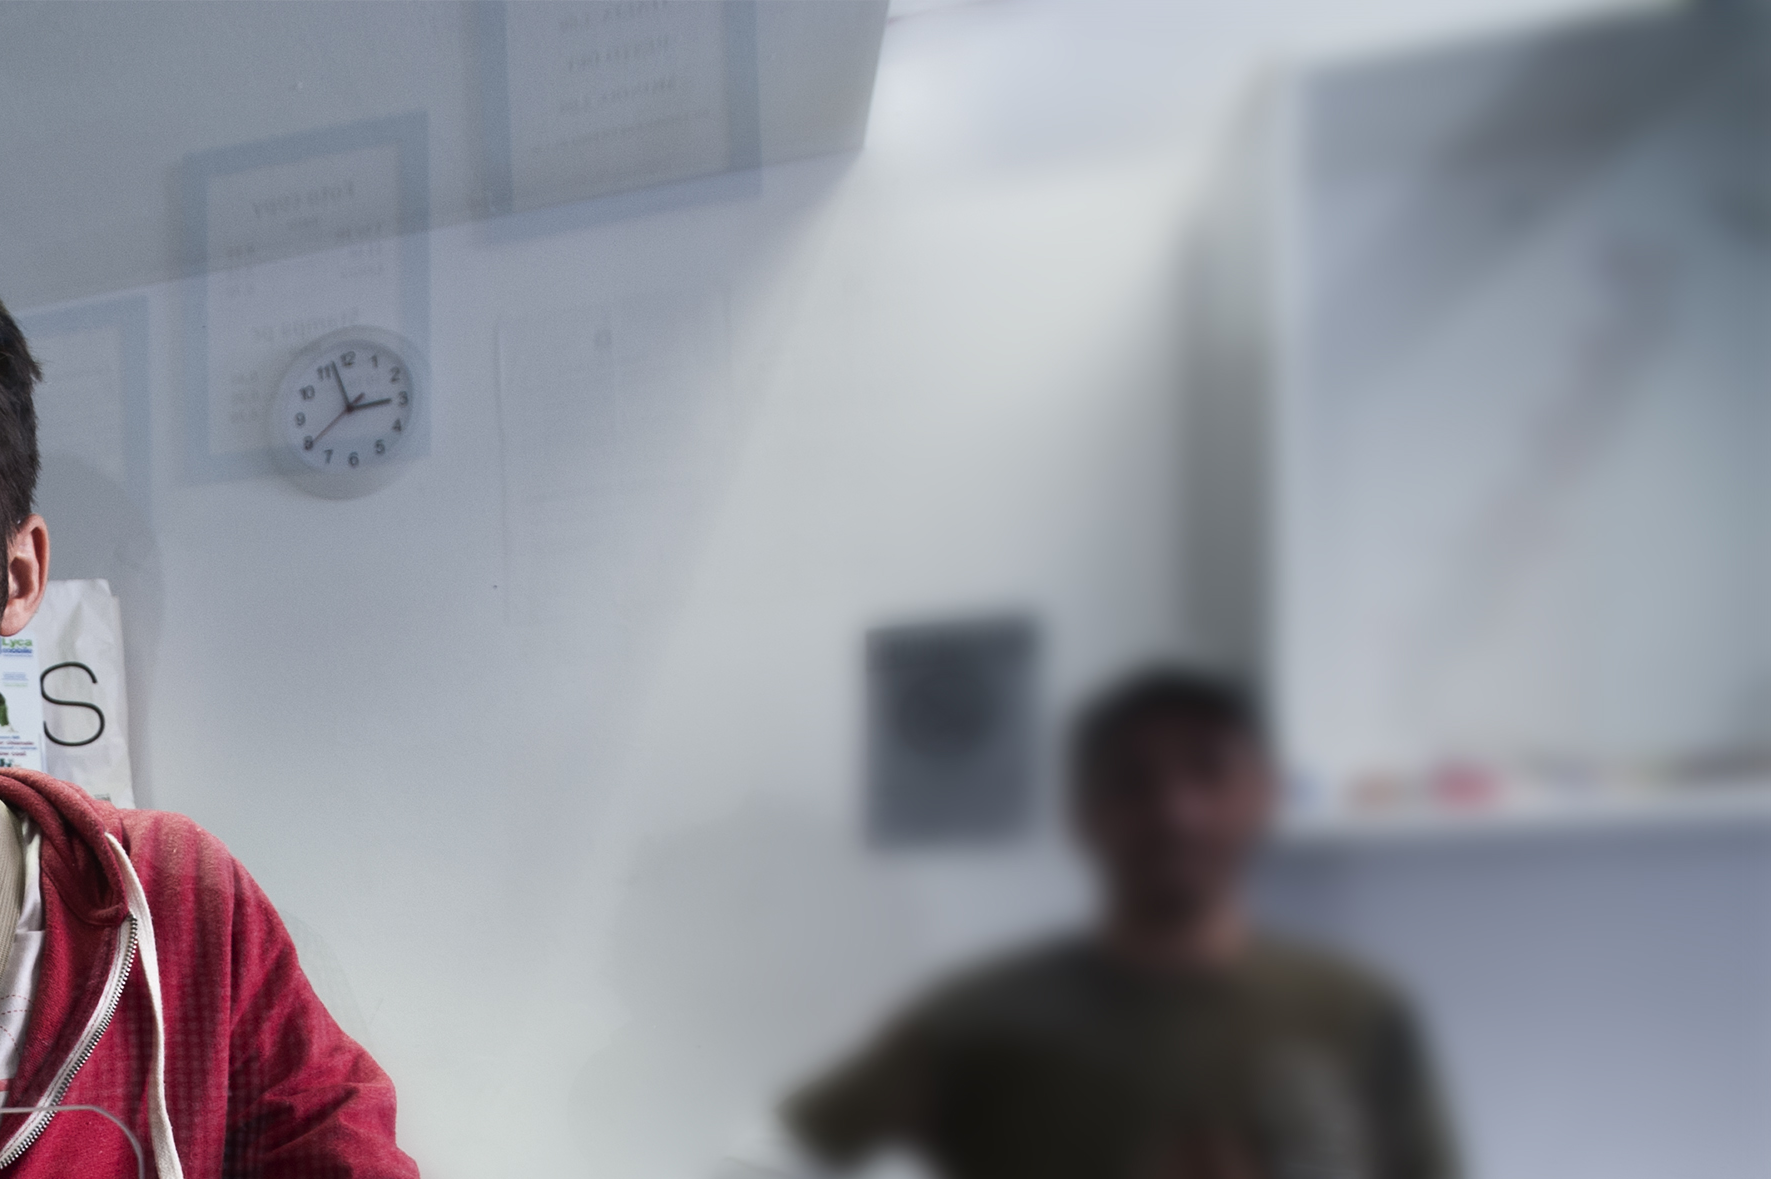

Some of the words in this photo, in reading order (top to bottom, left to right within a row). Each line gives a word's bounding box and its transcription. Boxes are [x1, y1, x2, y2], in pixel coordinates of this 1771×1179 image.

[340, 350, 356, 368] 12
[370, 354, 378, 368] 1
[317, 364, 331, 381] 11
[390, 366, 401, 383] 2
[299, 385, 315, 400] 10
[398, 391, 408, 407] 3
[295, 412, 306, 427] 9
[392, 418, 402, 432] 4
[303, 435, 314, 450] 8
[374, 439, 385, 455] 5
[324, 449, 333, 464] 7
[348, 451, 359, 468] 6
[2, 638, 32, 648] Lyca
[40, 661, 105, 747] S
